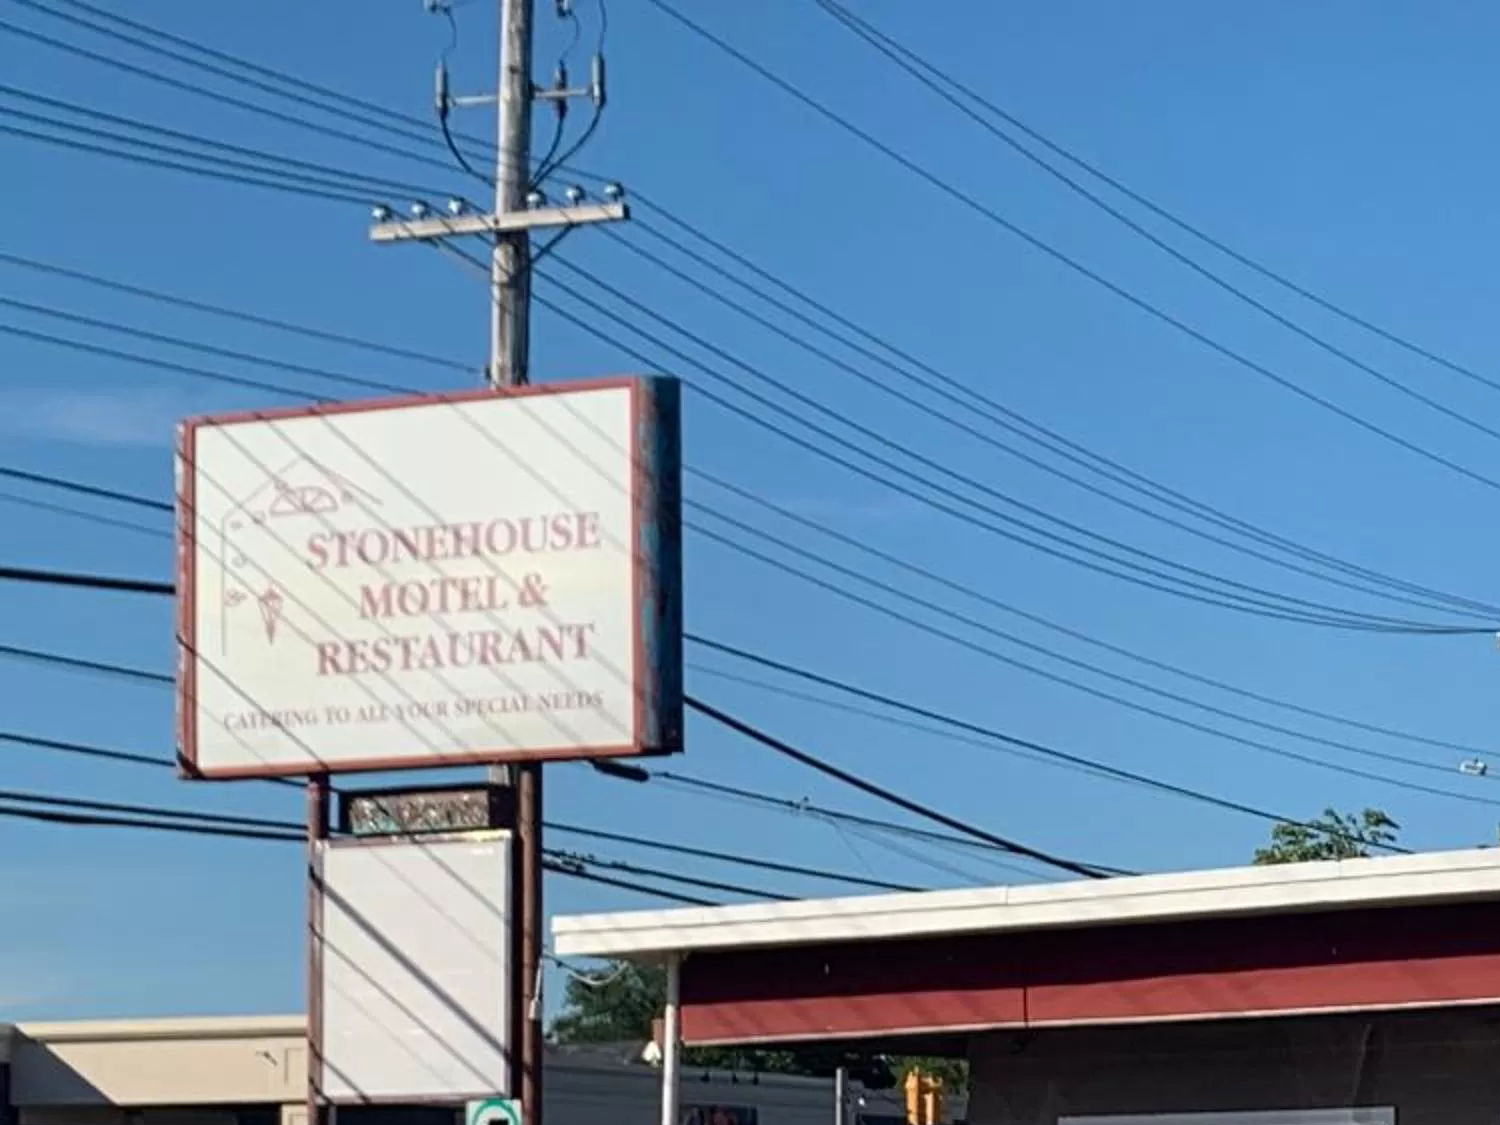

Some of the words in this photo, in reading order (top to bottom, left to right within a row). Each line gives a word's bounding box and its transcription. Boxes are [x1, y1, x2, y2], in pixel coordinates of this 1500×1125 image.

[306, 511, 602, 570] STONEHOUSE
[358, 575, 508, 620] MOTEL
[518, 572, 549, 609] &
[315, 622, 597, 677] RESTAURANT
[223, 707, 319, 731] CATERING
[324, 704, 350, 725] TO
[355, 702, 388, 722] ALL
[395, 699, 448, 719] YOUR
[454, 694, 529, 716] SPECIAL
[536, 690, 604, 710] NEEDS
